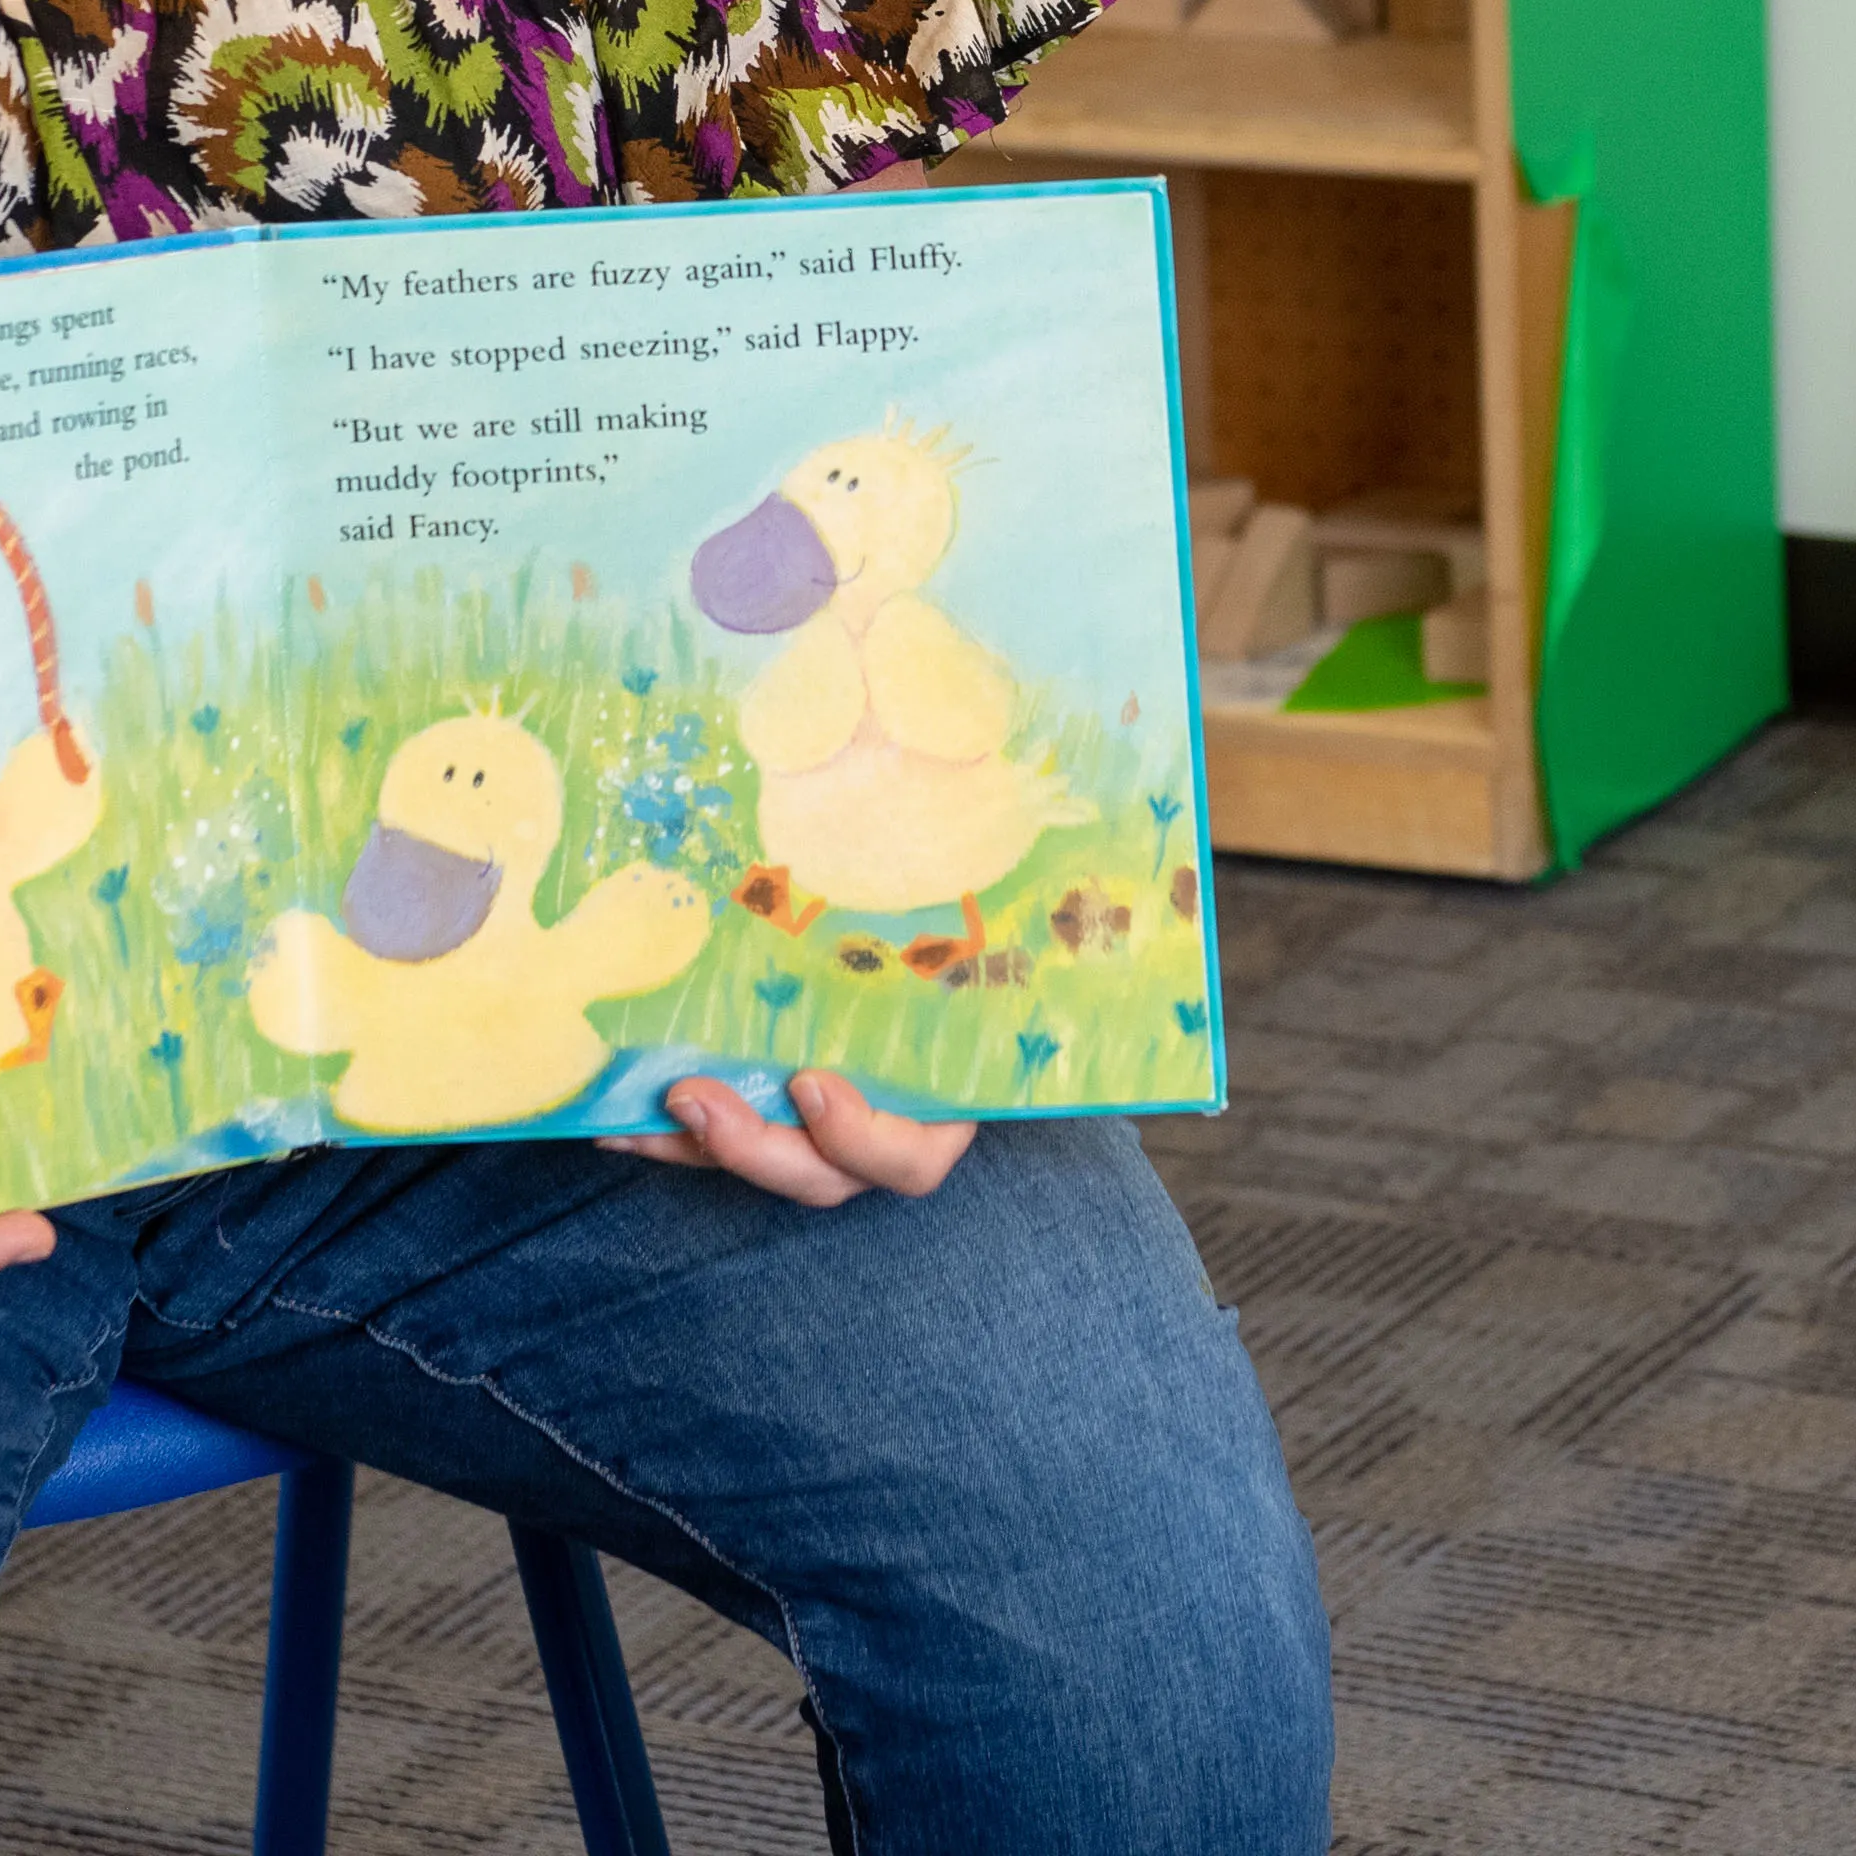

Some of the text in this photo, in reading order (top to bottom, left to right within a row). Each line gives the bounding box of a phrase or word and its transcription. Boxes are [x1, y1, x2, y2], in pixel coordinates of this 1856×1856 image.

[403, 267, 519, 297] feathers
[531, 271, 576, 291] are
[589, 259, 671, 292] fuzzy
[798, 246, 856, 276] said
[869, 241, 963, 277] Fluffy.
[50, 305, 115, 341] spent
[27, 352, 126, 388] running
[133, 345, 198, 371] races,
[369, 344, 437, 371] have
[450, 334, 567, 374] stopped
[744, 322, 802, 352] said
[815, 319, 920, 354] Flappy.
[51, 400, 137, 435] rowing
[145, 393, 169, 420] in
[416, 421, 459, 441] we
[472, 419, 516, 439] are
[530, 406, 583, 436] still
[595, 402, 709, 436] making
[74, 437, 190, 482] the pond.
[335, 463, 438, 498] muddy
[339, 513, 500, 544] said Fancy.
